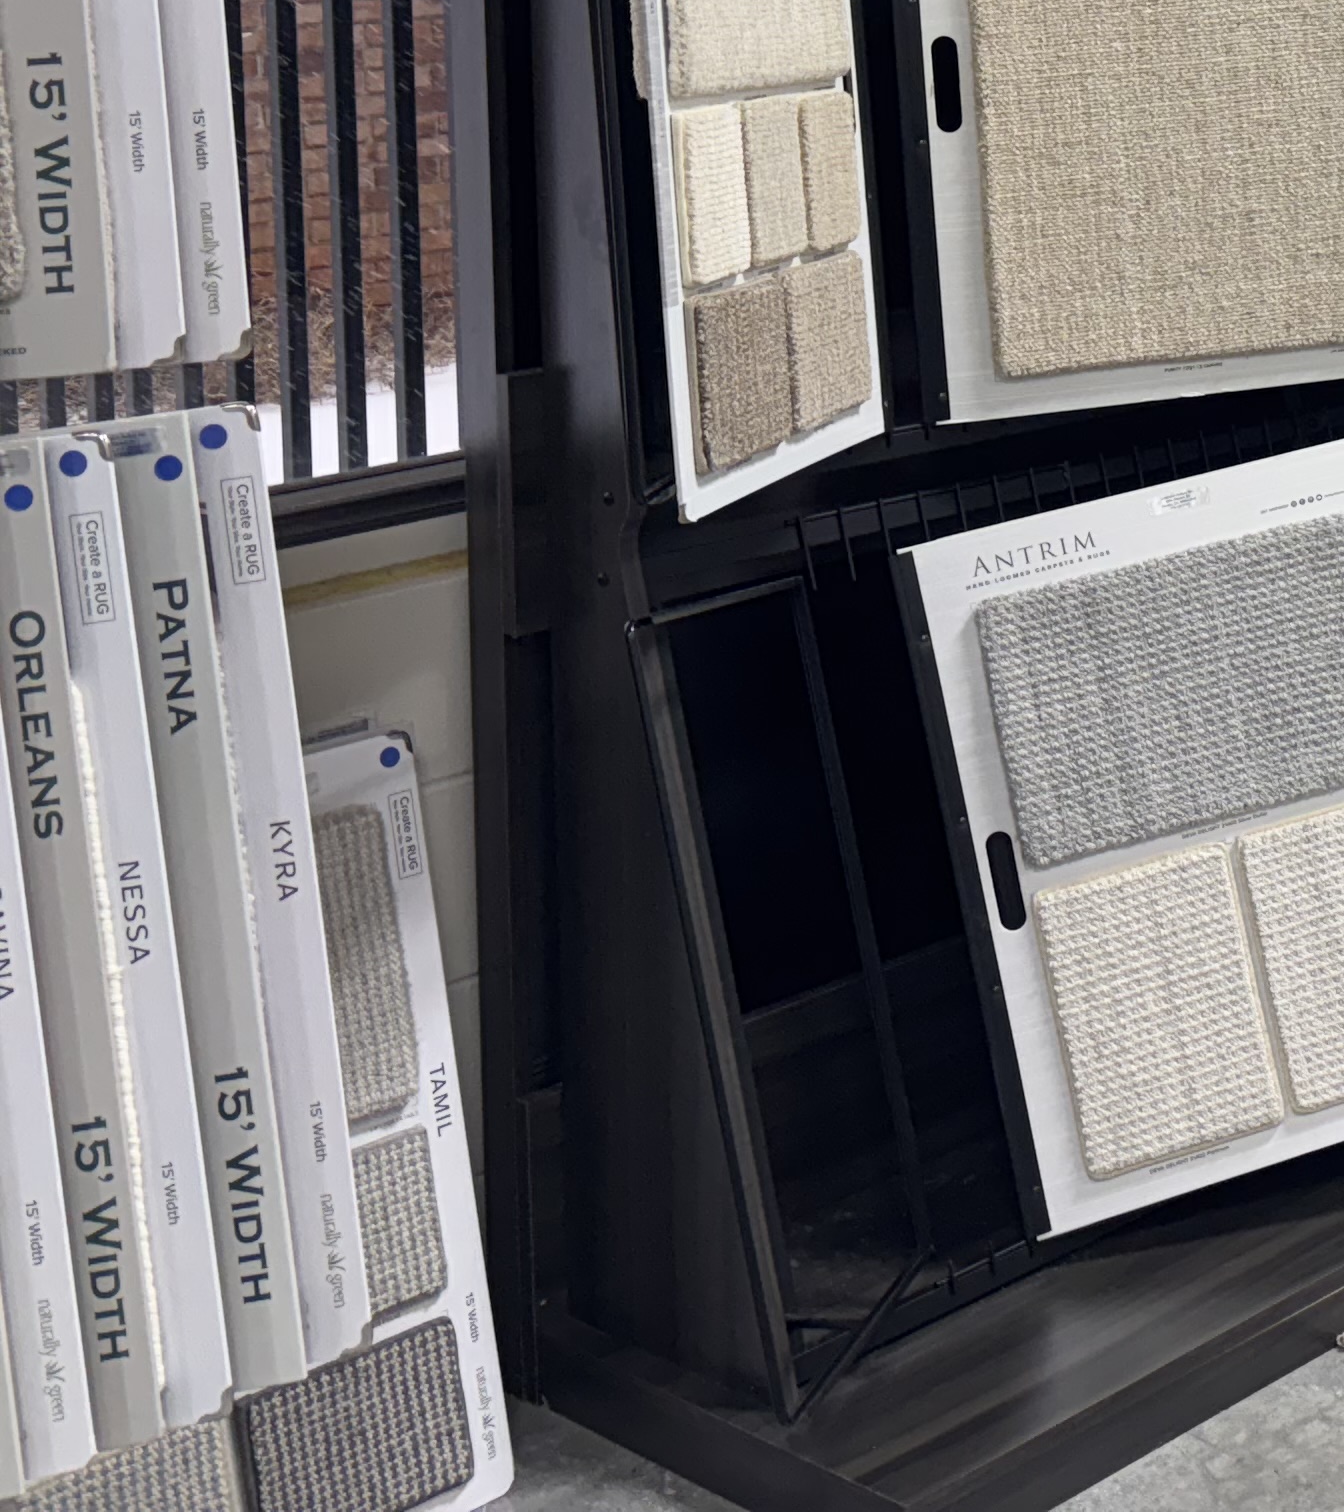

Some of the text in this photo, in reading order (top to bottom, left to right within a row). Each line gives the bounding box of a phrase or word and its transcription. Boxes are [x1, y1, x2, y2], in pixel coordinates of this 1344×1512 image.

[26, 52, 75, 295] 15' WIDTH
[129, 110, 145, 173] 15' Width
[200, 201, 220, 316] naturally green
[85, 520, 110, 615] Create a RUG
[973, 531, 1096, 578] ANTRIM
[152, 577, 198, 736] PATNA
[8, 610, 63, 840] ORLEANS
[269, 819, 299, 902] KYRA
[117, 860, 151, 966] NESSA
[310, 1100, 328, 1163] 15' Width
[428, 1062, 454, 1137] TAMIL
[71, 1115, 131, 1363] 15' WIDTH
